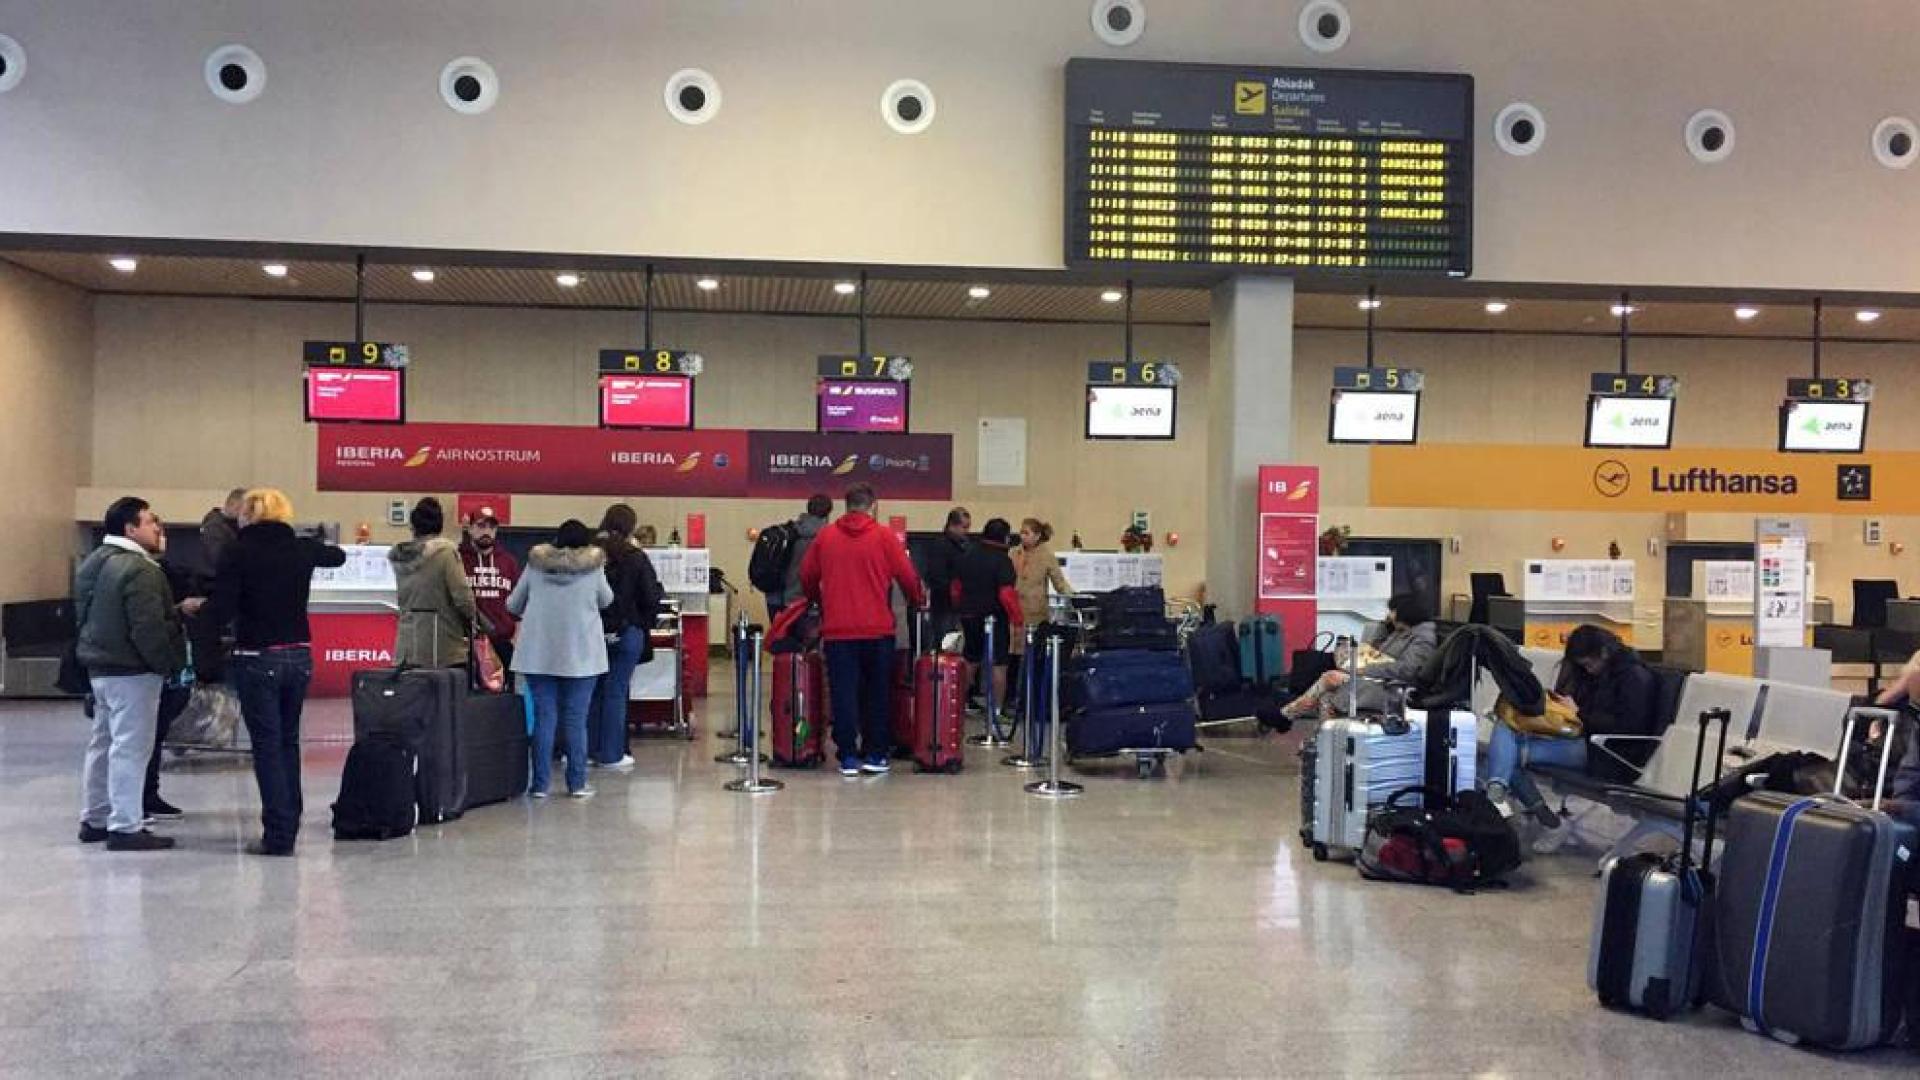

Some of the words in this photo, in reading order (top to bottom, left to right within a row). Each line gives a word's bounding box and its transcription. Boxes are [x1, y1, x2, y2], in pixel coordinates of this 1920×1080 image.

[1272, 77, 1315, 90] Abiadak
[1272, 90, 1326, 103] Departures
[363, 343, 378, 364] 9
[656, 351, 671, 371] 8
[873, 356, 887, 376] 7
[1141, 362, 1156, 383] 6
[1386, 368, 1398, 388] 5
[1641, 375, 1655, 394] 4
[1836, 379, 1848, 398] 3
[336, 446, 403, 460] IBERIA
[436, 449, 541, 463] AIRNOSTRUM
[611, 451, 675, 465] IBERIA
[770, 454, 832, 467] IBERIA
[1269, 481, 1287, 493] IB
[1651, 466, 1798, 494] Lufthansa
[325, 649, 392, 662] IBERIA
